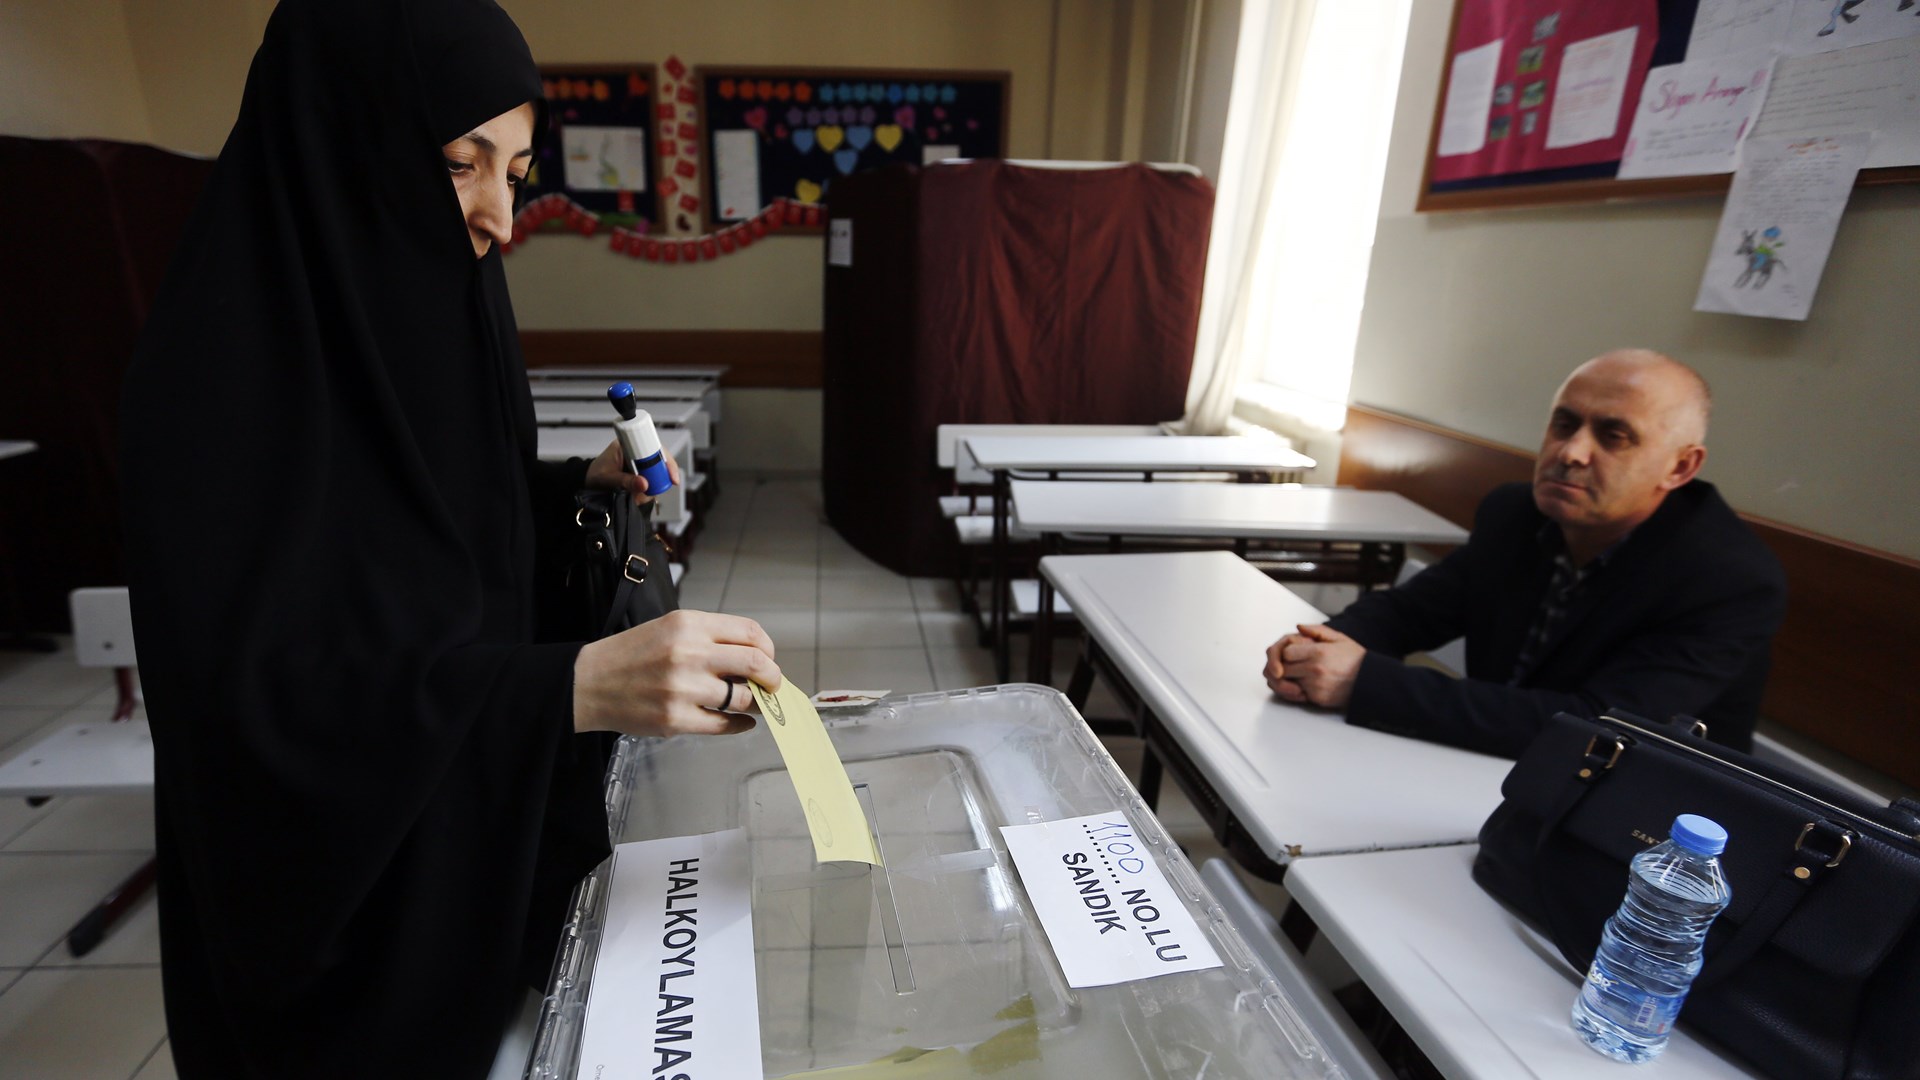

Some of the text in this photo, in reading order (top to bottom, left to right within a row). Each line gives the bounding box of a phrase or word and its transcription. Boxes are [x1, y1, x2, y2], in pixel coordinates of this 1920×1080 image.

[1063, 853, 1126, 934] SANDIK
[1091, 822, 1187, 961] 1100 NO.LU
